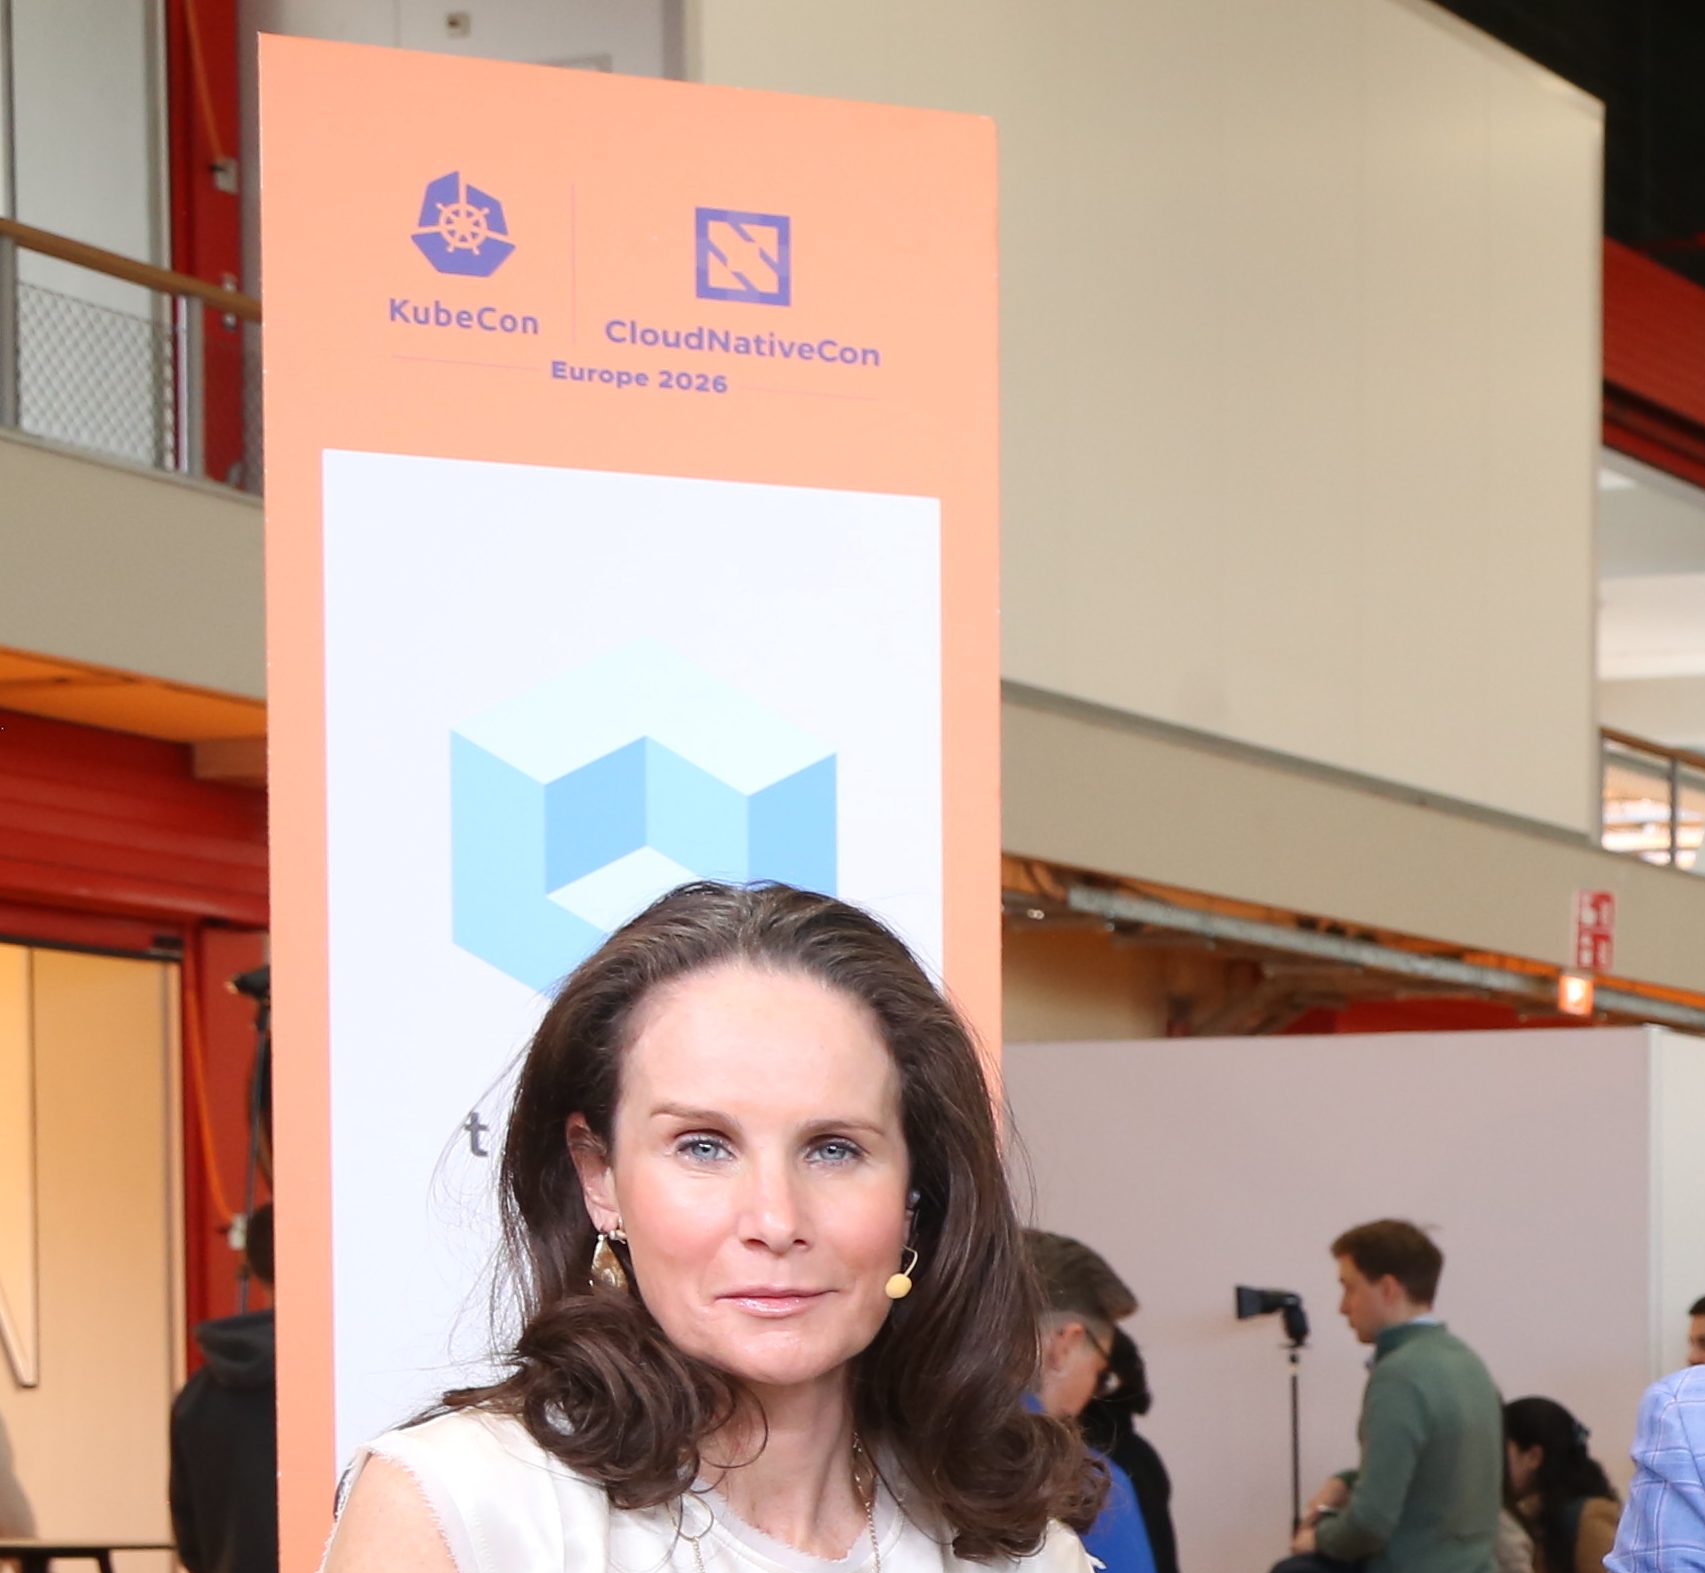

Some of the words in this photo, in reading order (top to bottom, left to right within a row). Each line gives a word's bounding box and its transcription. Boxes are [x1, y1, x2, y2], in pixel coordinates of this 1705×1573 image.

[389, 297, 540, 336] KubeCon
[604, 320, 882, 367] CloudNativeCon
[550, 360, 650, 390] Europe
[657, 369, 729, 395] 2026
